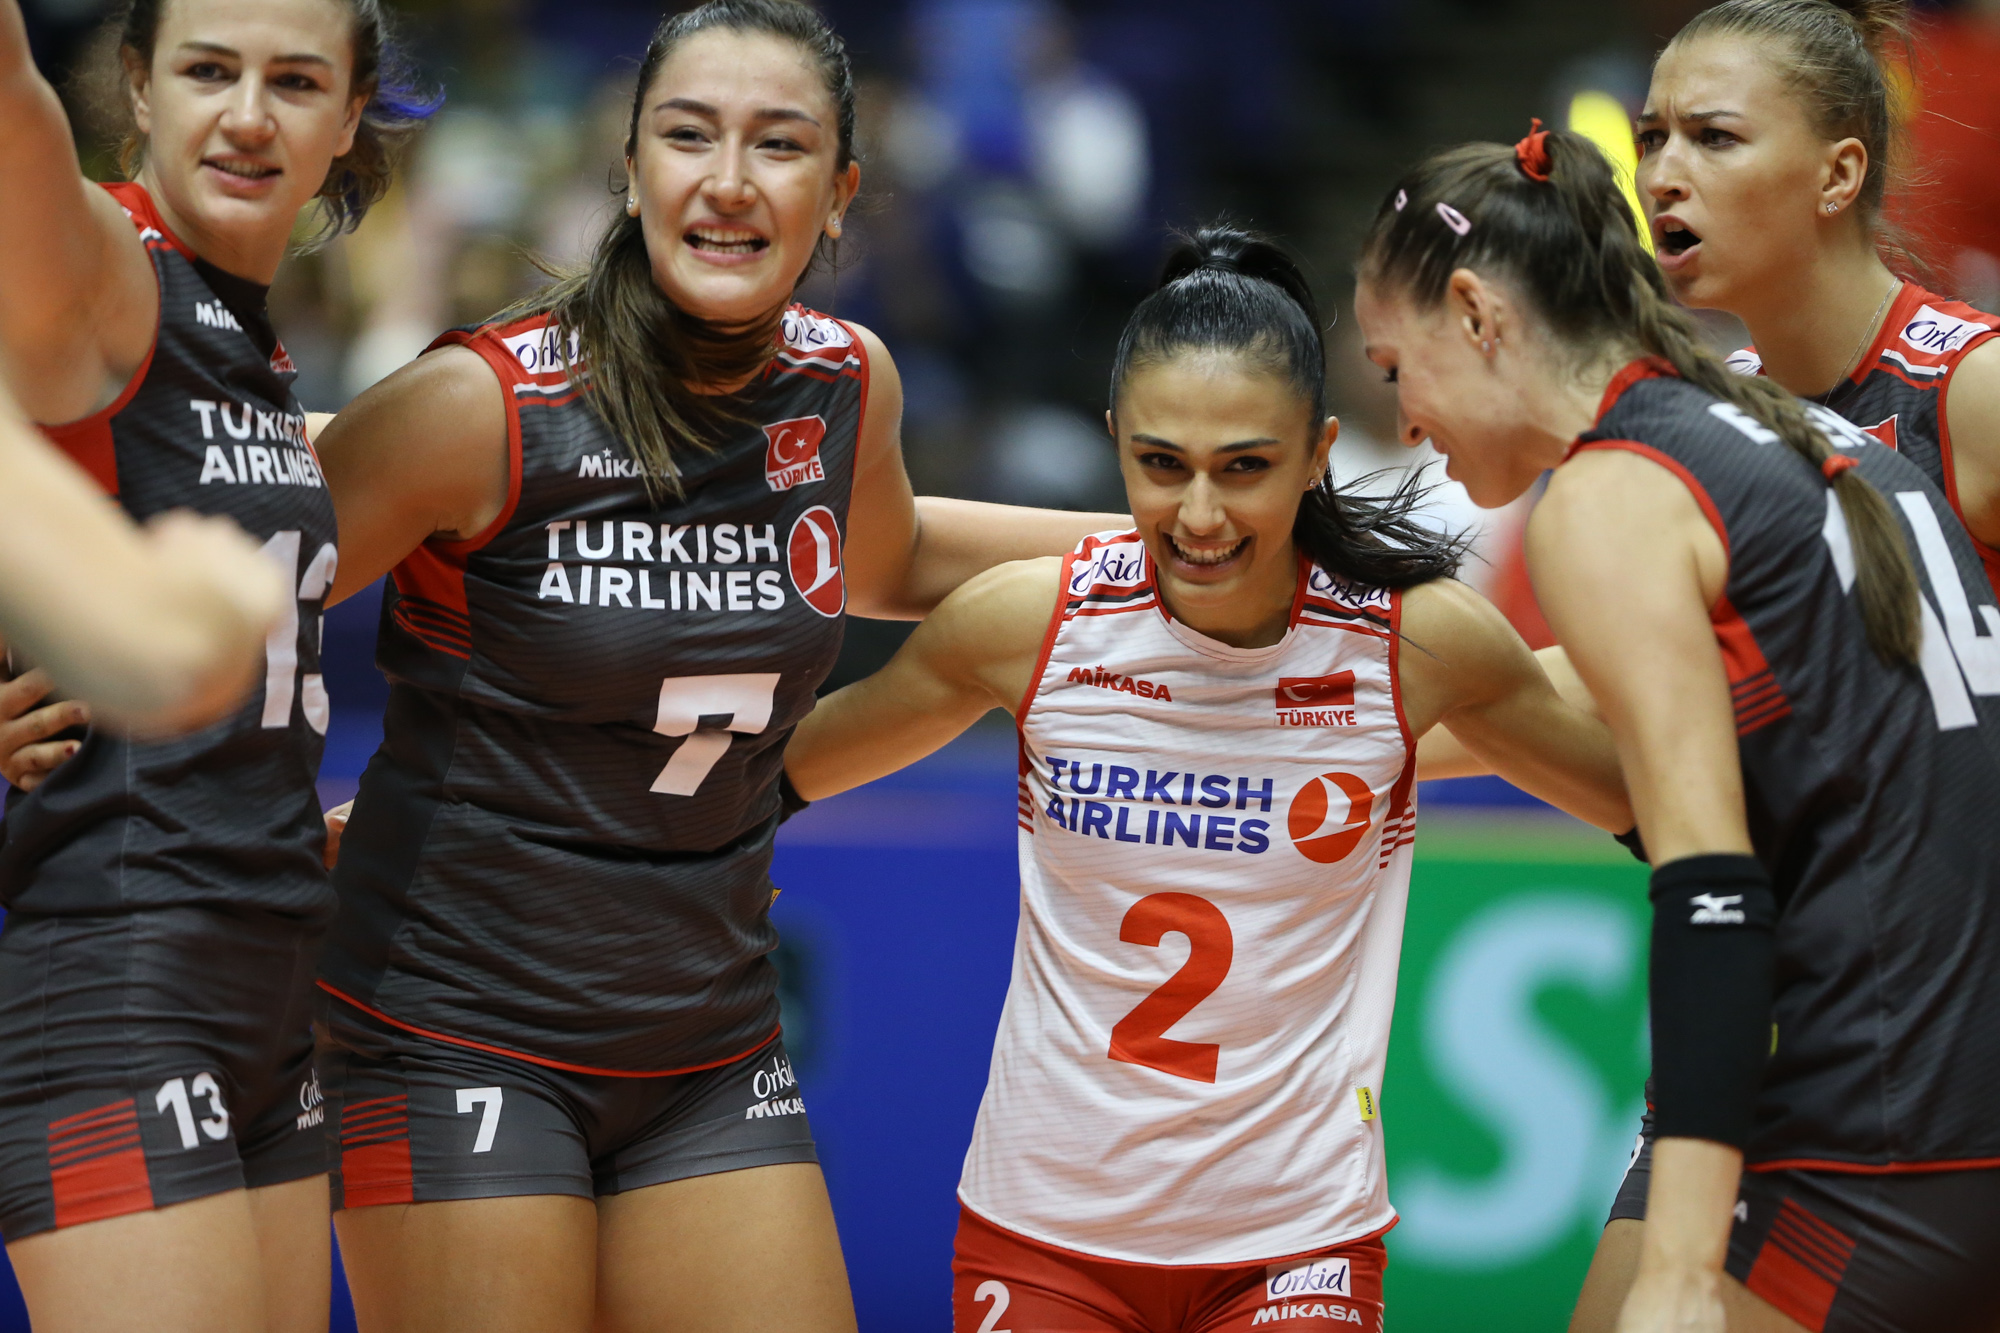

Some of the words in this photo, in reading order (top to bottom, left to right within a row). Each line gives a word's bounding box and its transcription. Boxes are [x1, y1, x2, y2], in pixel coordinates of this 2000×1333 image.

[195, 298, 243, 332] MIK
[516, 331, 580, 369] Orki
[199, 445, 322, 488] AIRLINES
[578, 446, 683, 479] MIKAA
[544, 520, 780, 565] TURKISH
[537, 562, 786, 611] AIRLINES
[649, 673, 781, 797] 7
[1045, 756, 1273, 812] TURKISH
[1045, 794, 1271, 854] AIRLINES
[1107, 892, 1234, 1084] 2
[156, 1072, 229, 1150] 13
[300, 1067, 324, 1112] Ork
[745, 1095, 806, 1120] MIKAS
[297, 1106, 324, 1131] MIK
[456, 1086, 503, 1153] 7
[1270, 1263, 1344, 1295] Orkid
[973, 1280, 1011, 1333] 2
